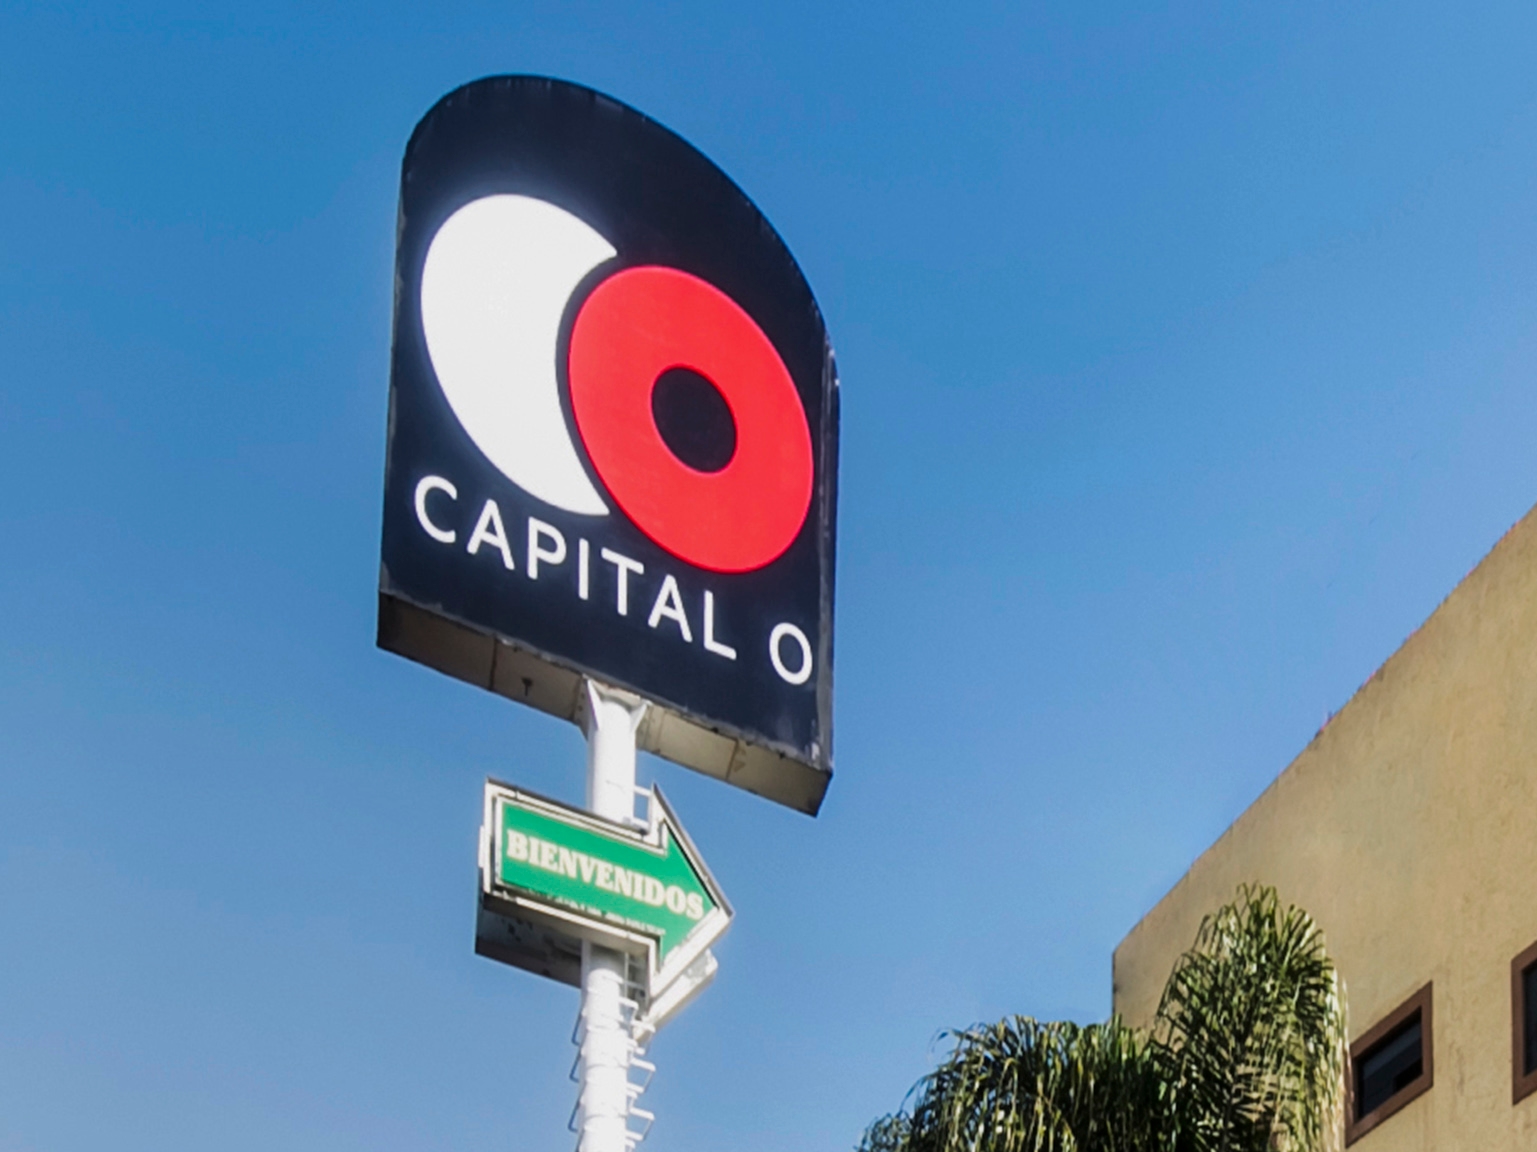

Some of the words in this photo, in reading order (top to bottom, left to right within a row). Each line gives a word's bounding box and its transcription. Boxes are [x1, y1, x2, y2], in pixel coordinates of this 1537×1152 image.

[414, 475, 737, 660] CAPITAL
[768, 622, 813, 685] O
[506, 828, 705, 921] BIENVENIDOS
